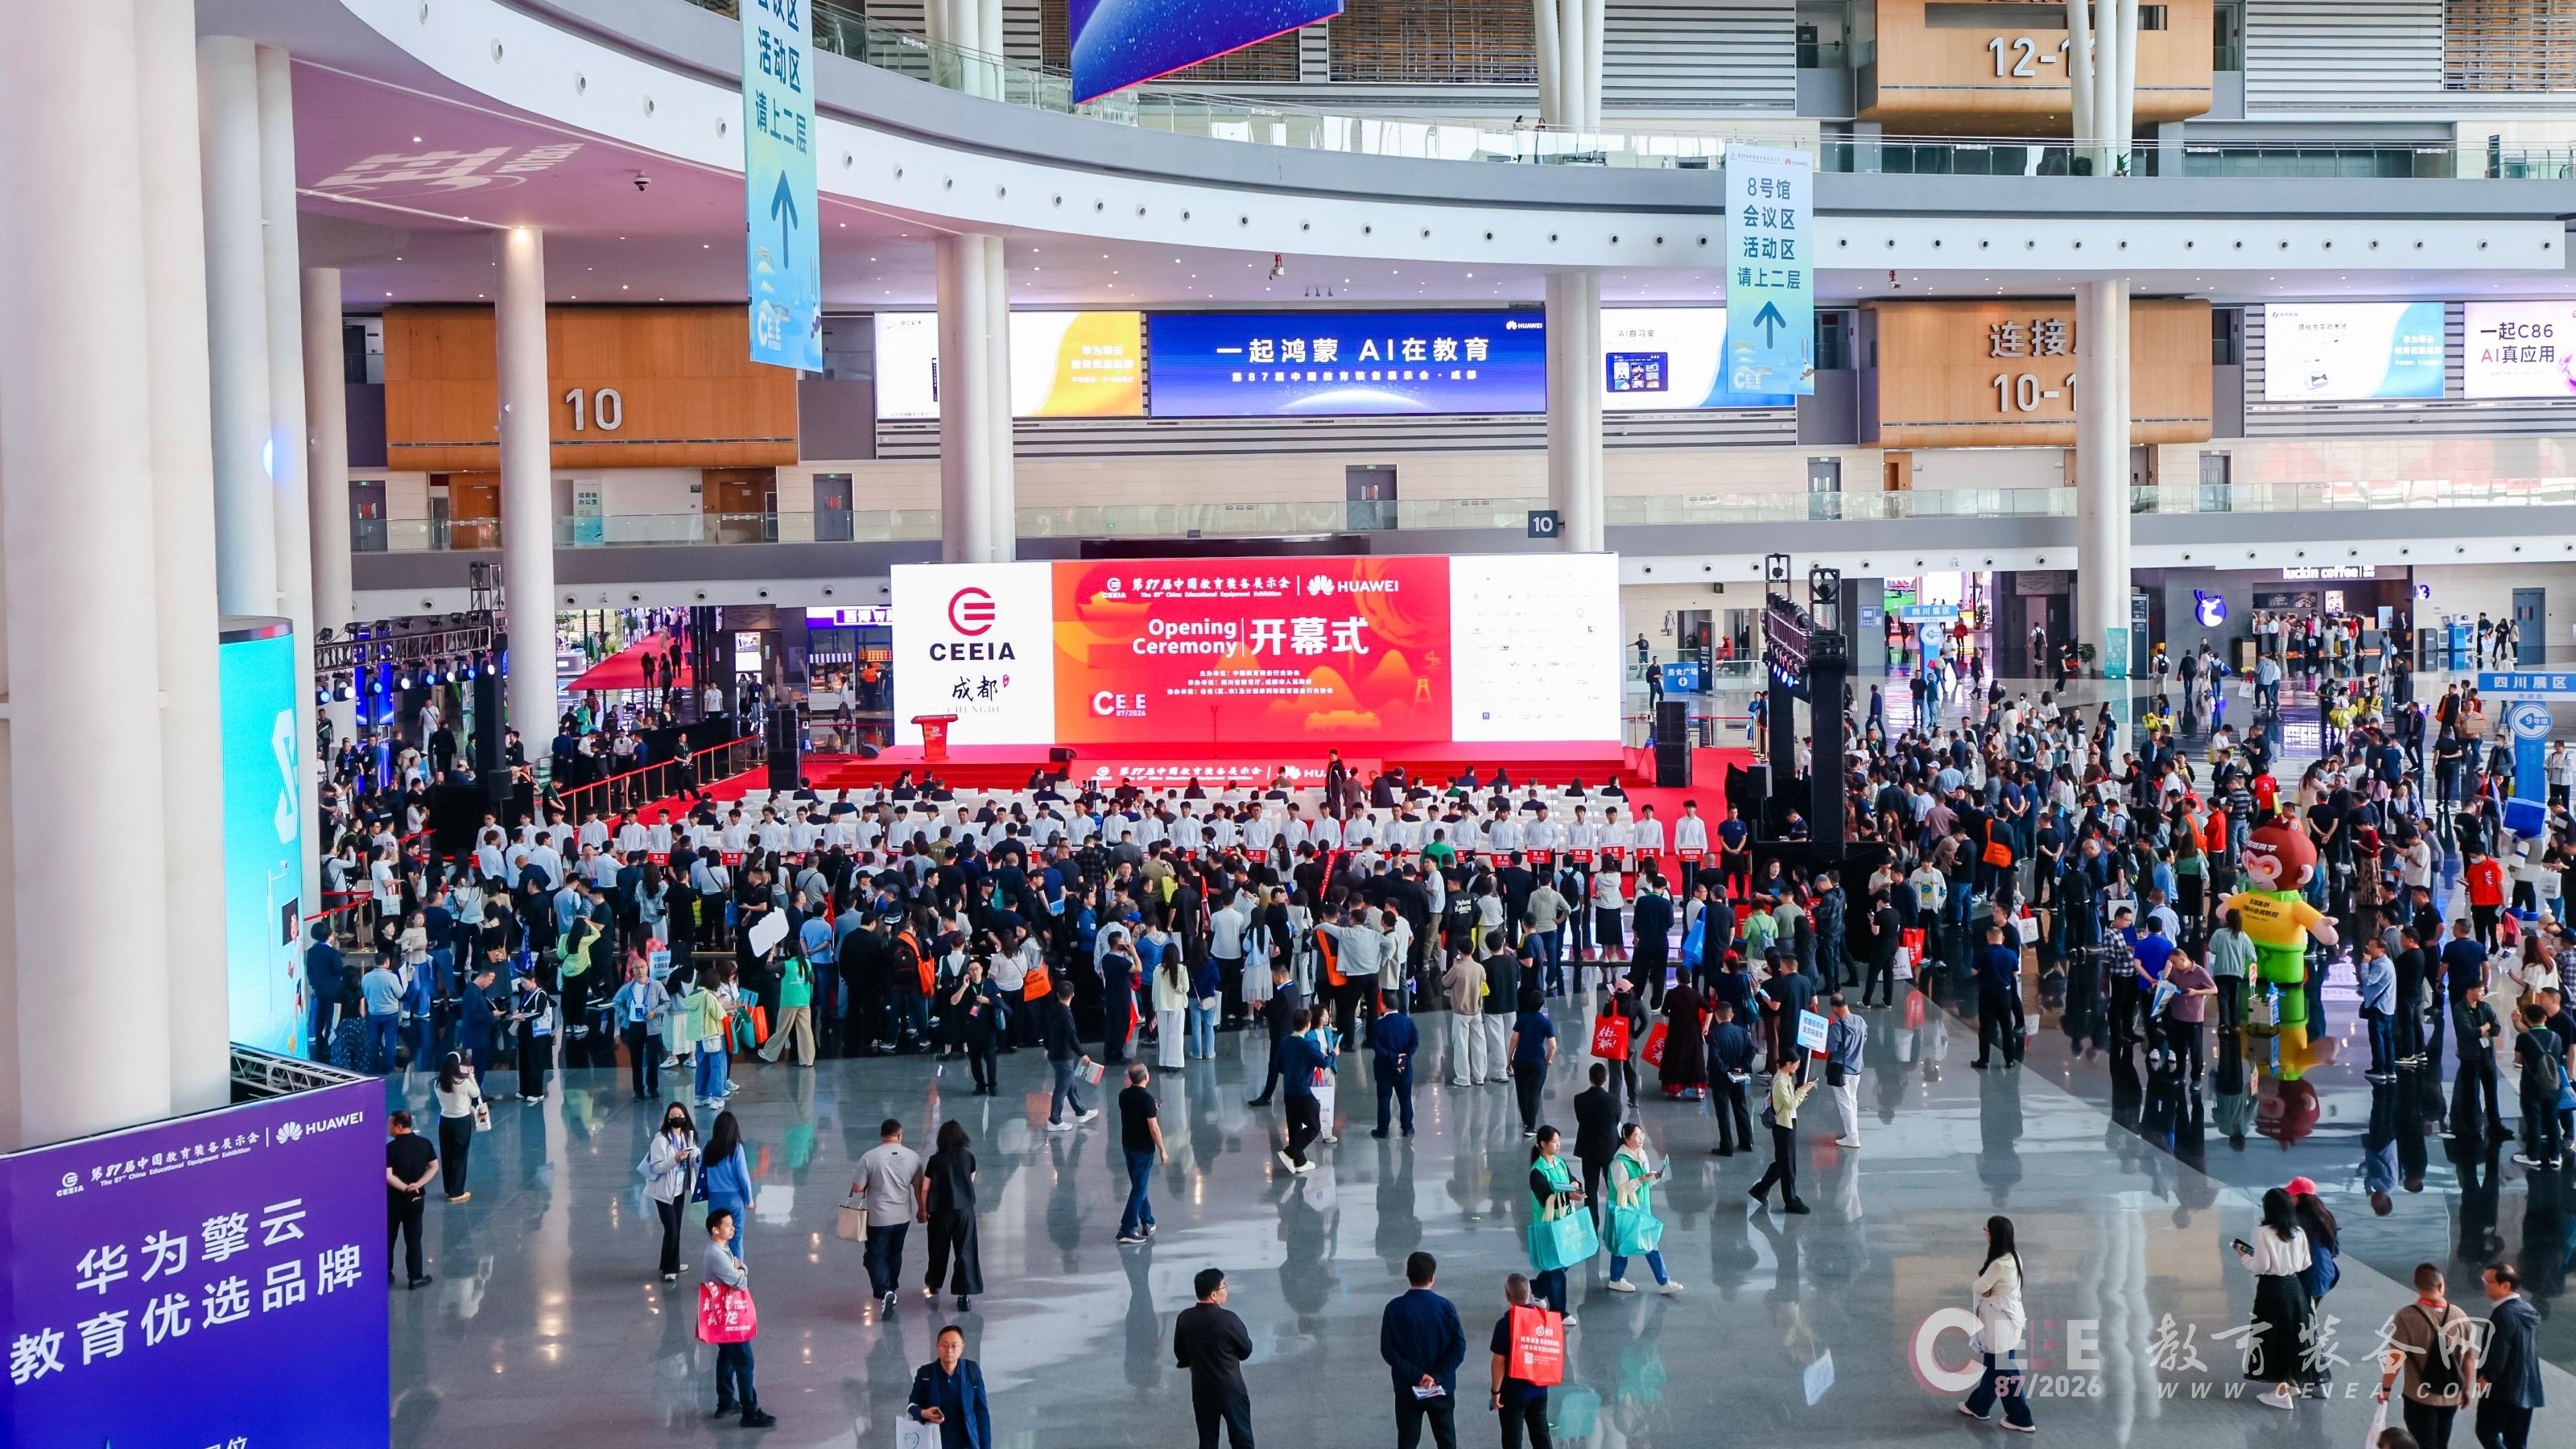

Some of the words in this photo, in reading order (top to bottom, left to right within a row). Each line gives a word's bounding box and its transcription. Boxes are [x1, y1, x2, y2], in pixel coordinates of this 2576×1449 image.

[758, 26, 801, 94] 活动区
[1988, 37, 2095, 76] 12-
[755, 90, 807, 155] 请上二层
[1748, 177, 1791, 200] 8号馆
[1743, 204, 1795, 230] 会议区
[1744, 236, 1795, 260] 活动区
[1737, 266, 1801, 290] 请上二层
[1618, 329, 1655, 338] AI自习室
[1989, 319, 2076, 357] 连接
[2480, 322, 2553, 341] 一起C86
[1216, 338, 1339, 363] 一起鸿蒙
[1358, 336, 1489, 362] AI在教育
[2481, 345, 2554, 364] AI真应用
[1993, 374, 2076, 412] 10-1
[566, 388, 622, 431] 10
[1533, 516, 1554, 533] 10
[2283, 567, 2318, 580] luckin
[2321, 565, 2359, 579] coffee
[1337, 580, 1399, 592] HUAWEI
[1148, 618, 1237, 639] Opening
[1249, 616, 1369, 657] 开幕式
[929, 642, 1016, 662] CEEIA
[1132, 638, 1238, 658] Ceremony
[952, 675, 998, 702] 成都
[2494, 676, 2567, 689] 四川展区
[305, 1111, 364, 1136] HUAWEI
[90, 1130, 260, 1183] 第87届中国教育装备展示会
[100, 1179, 113, 1187] The
[128, 1170, 147, 1180] China
[149, 1162, 184, 1176] Educational
[187, 1153, 219, 1167] Equipment
[221, 1146, 251, 1158] Exhibition
[56, 1184, 85, 1198] CEEIA
[76, 1198, 307, 1295] 华为擎云
[10, 1244, 362, 1386] 教育优选品牌
